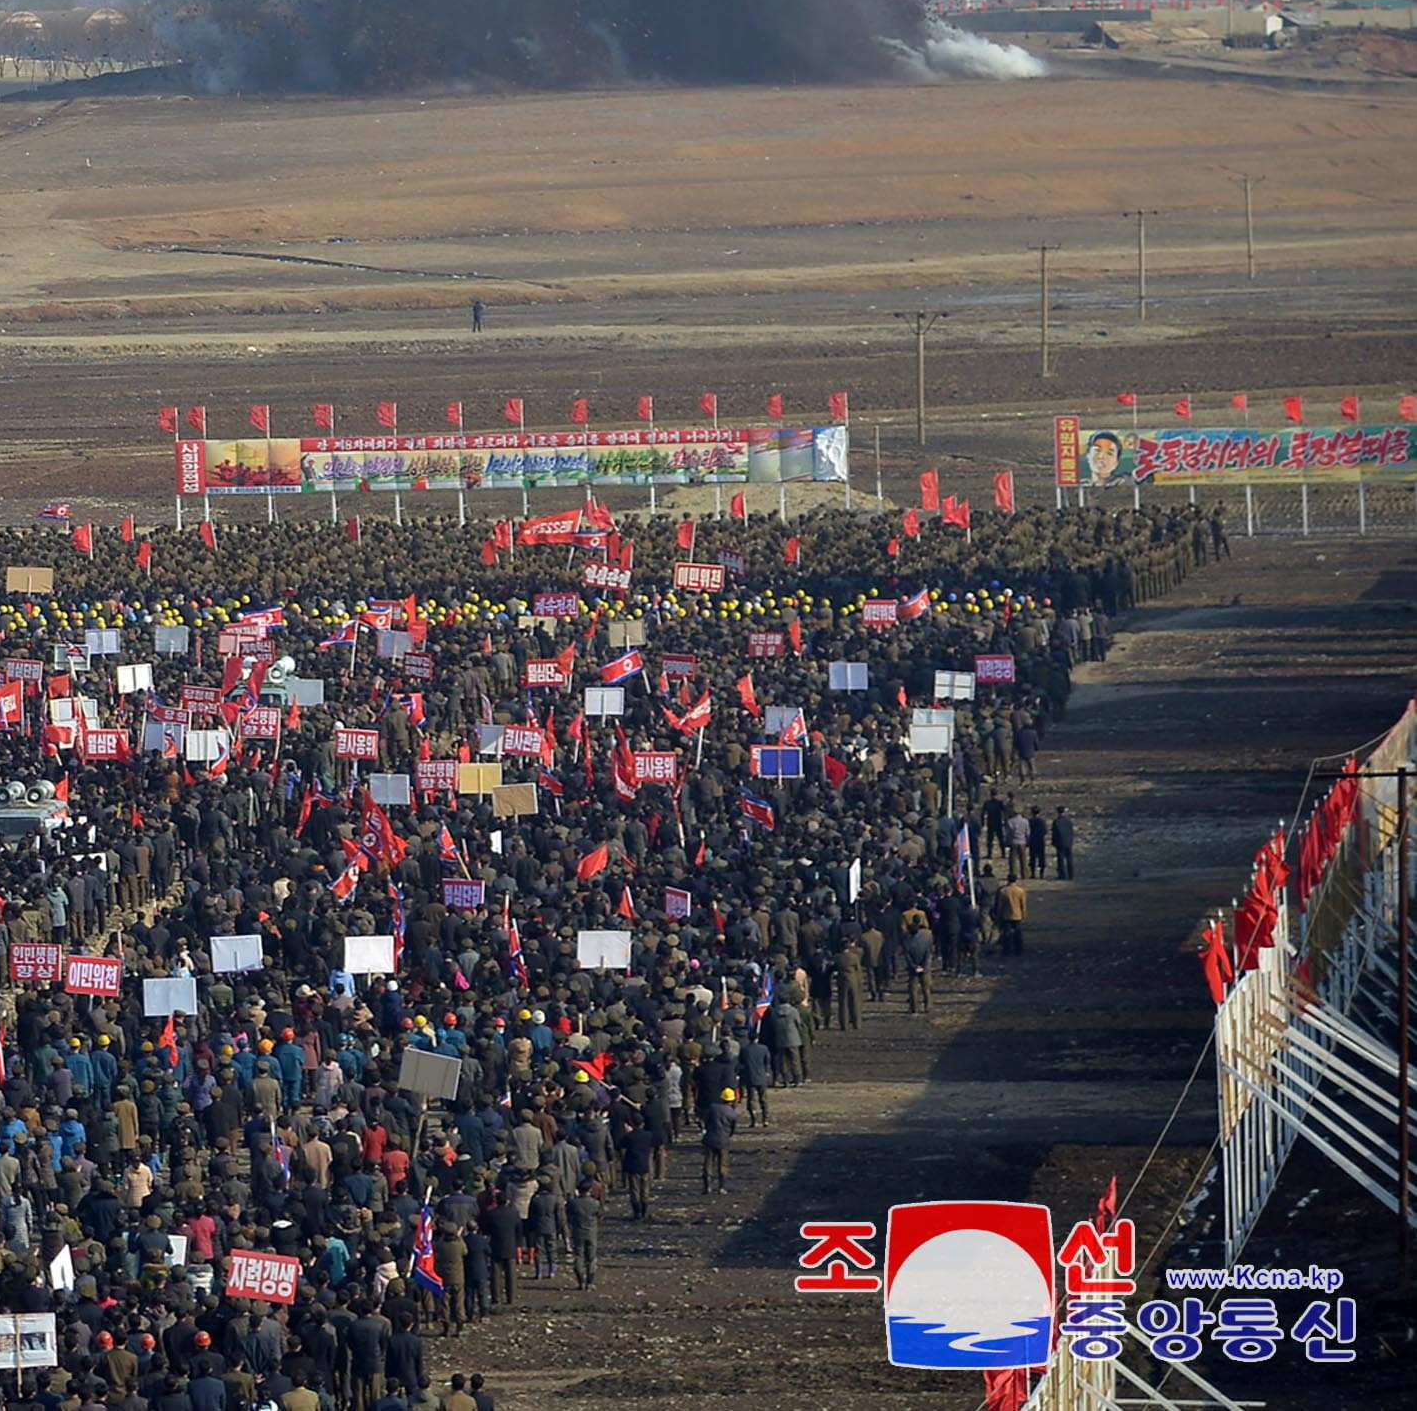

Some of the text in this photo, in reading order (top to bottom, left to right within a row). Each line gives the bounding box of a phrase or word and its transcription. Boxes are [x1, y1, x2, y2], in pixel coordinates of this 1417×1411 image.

[1133, 436, 1279, 482] 로동당시대의
[88, 733, 121, 754] 일심단
[12, 946, 58, 965] 인민생활
[16, 964, 55, 978] 향상
[69, 961, 119, 990] 이민위천
[229, 1255, 296, 1297] 자력갱생
